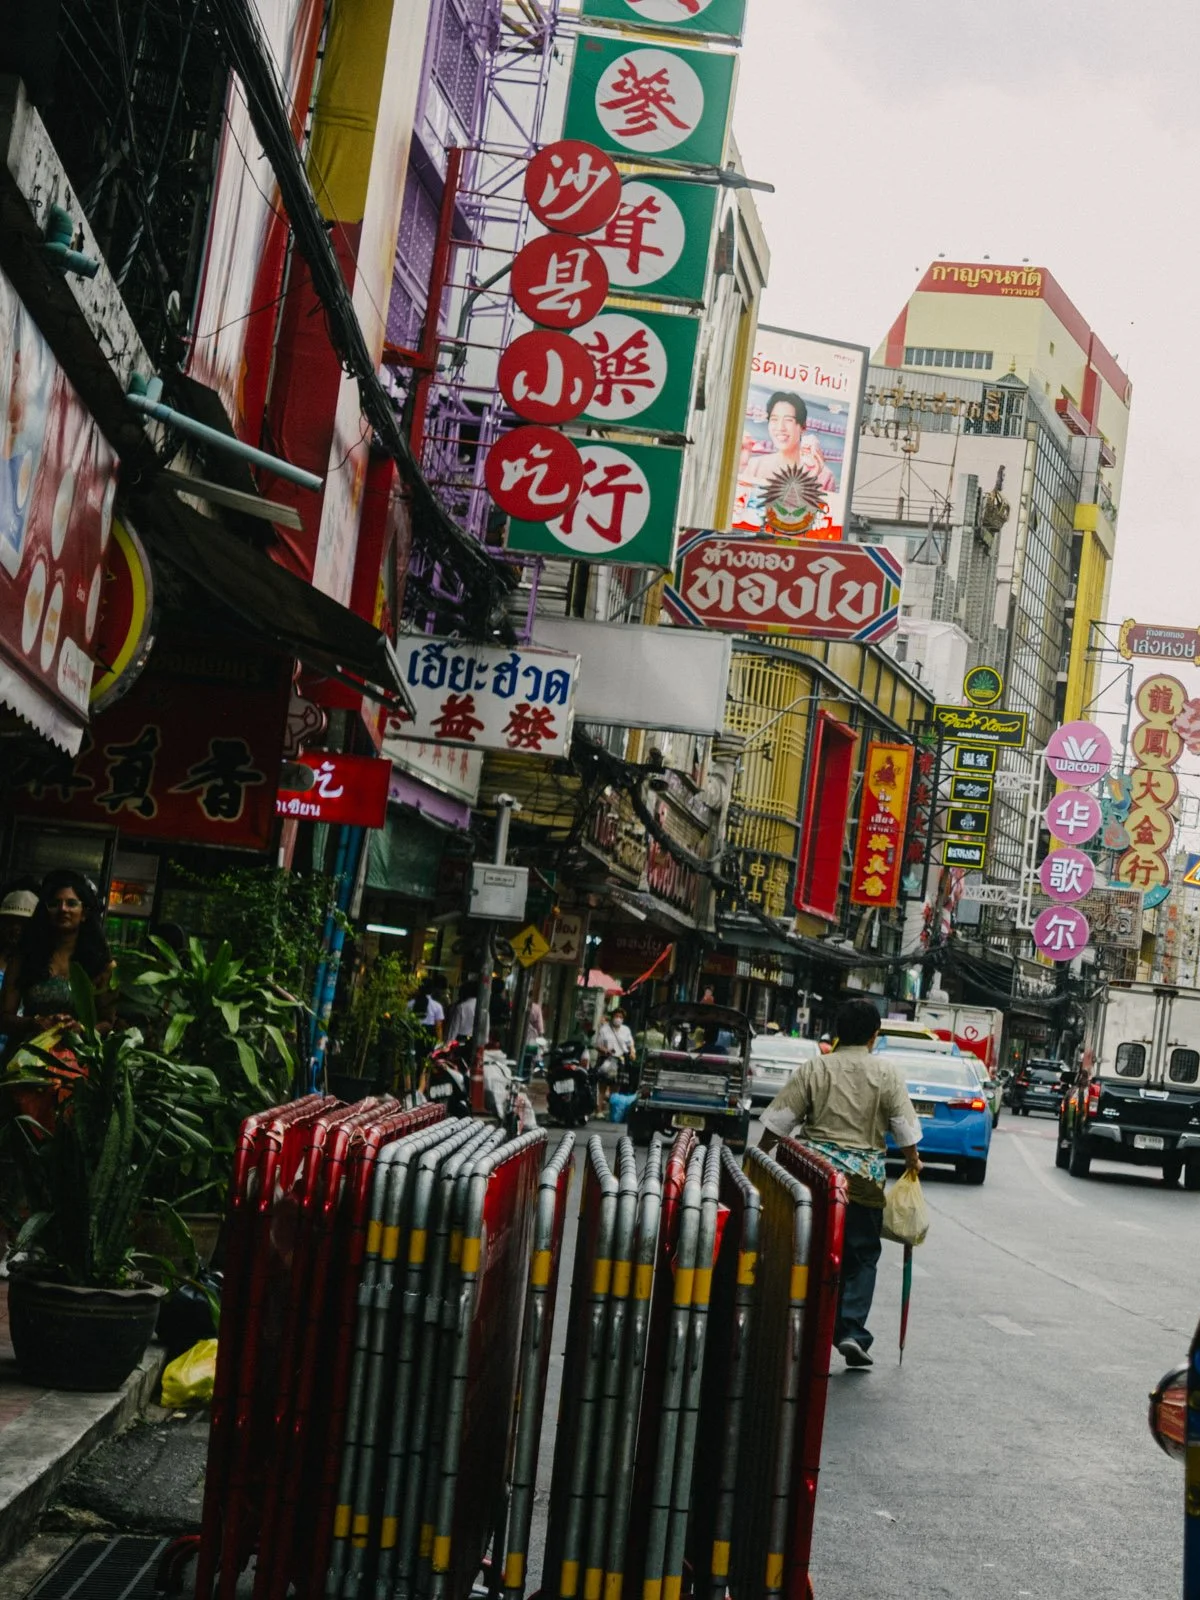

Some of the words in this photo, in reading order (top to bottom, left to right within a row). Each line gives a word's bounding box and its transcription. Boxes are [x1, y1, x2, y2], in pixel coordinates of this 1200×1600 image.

[500, 153, 612, 506] 沙县小吃
[686, 557, 878, 625] ทองใบ
[703, 542, 795, 572] ห้างทอง
[387, 693, 558, 752] 益發
[1055, 759, 1100, 774] Wacoal
[1127, 684, 1175, 885] 龍鳳大金行
[1044, 799, 1091, 952] 华歌尔
